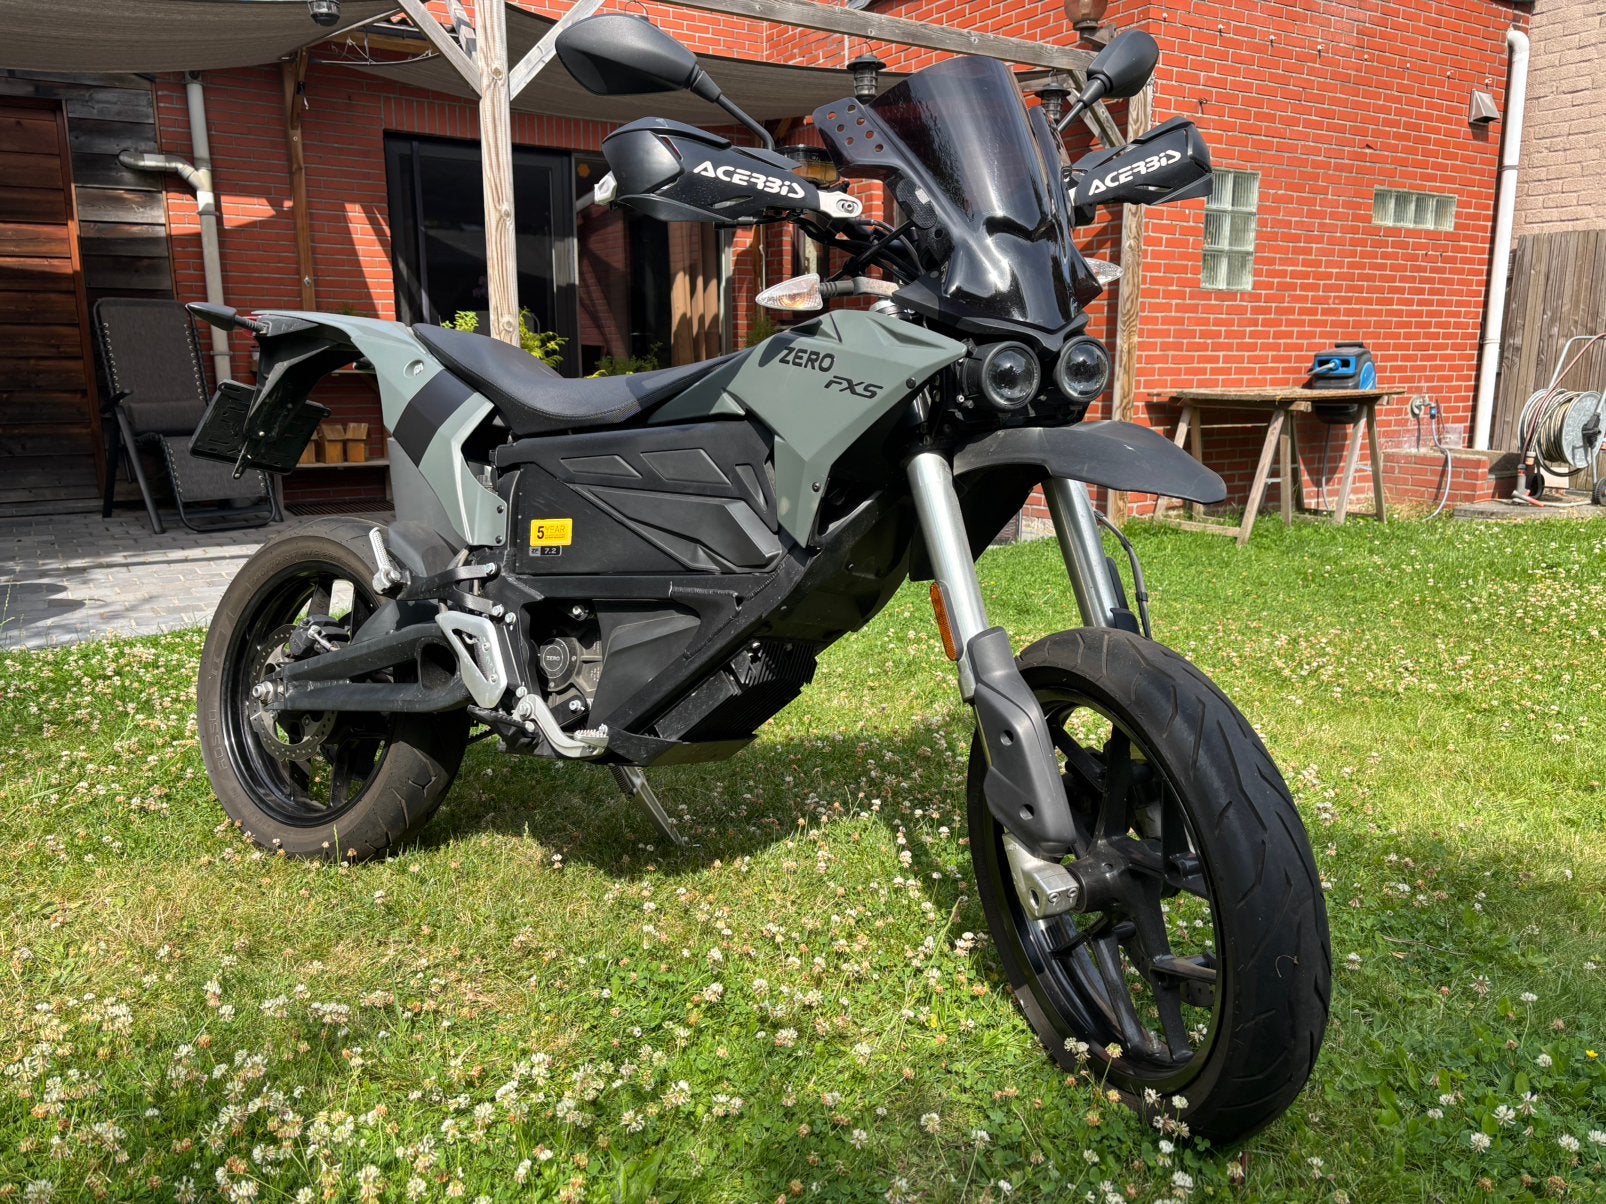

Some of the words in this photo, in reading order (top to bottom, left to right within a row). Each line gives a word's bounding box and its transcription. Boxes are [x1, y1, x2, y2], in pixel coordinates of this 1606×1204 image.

[778, 346, 836, 373] ZERO
[824, 375, 884, 400] FXS
[537, 526, 544, 539] 5
